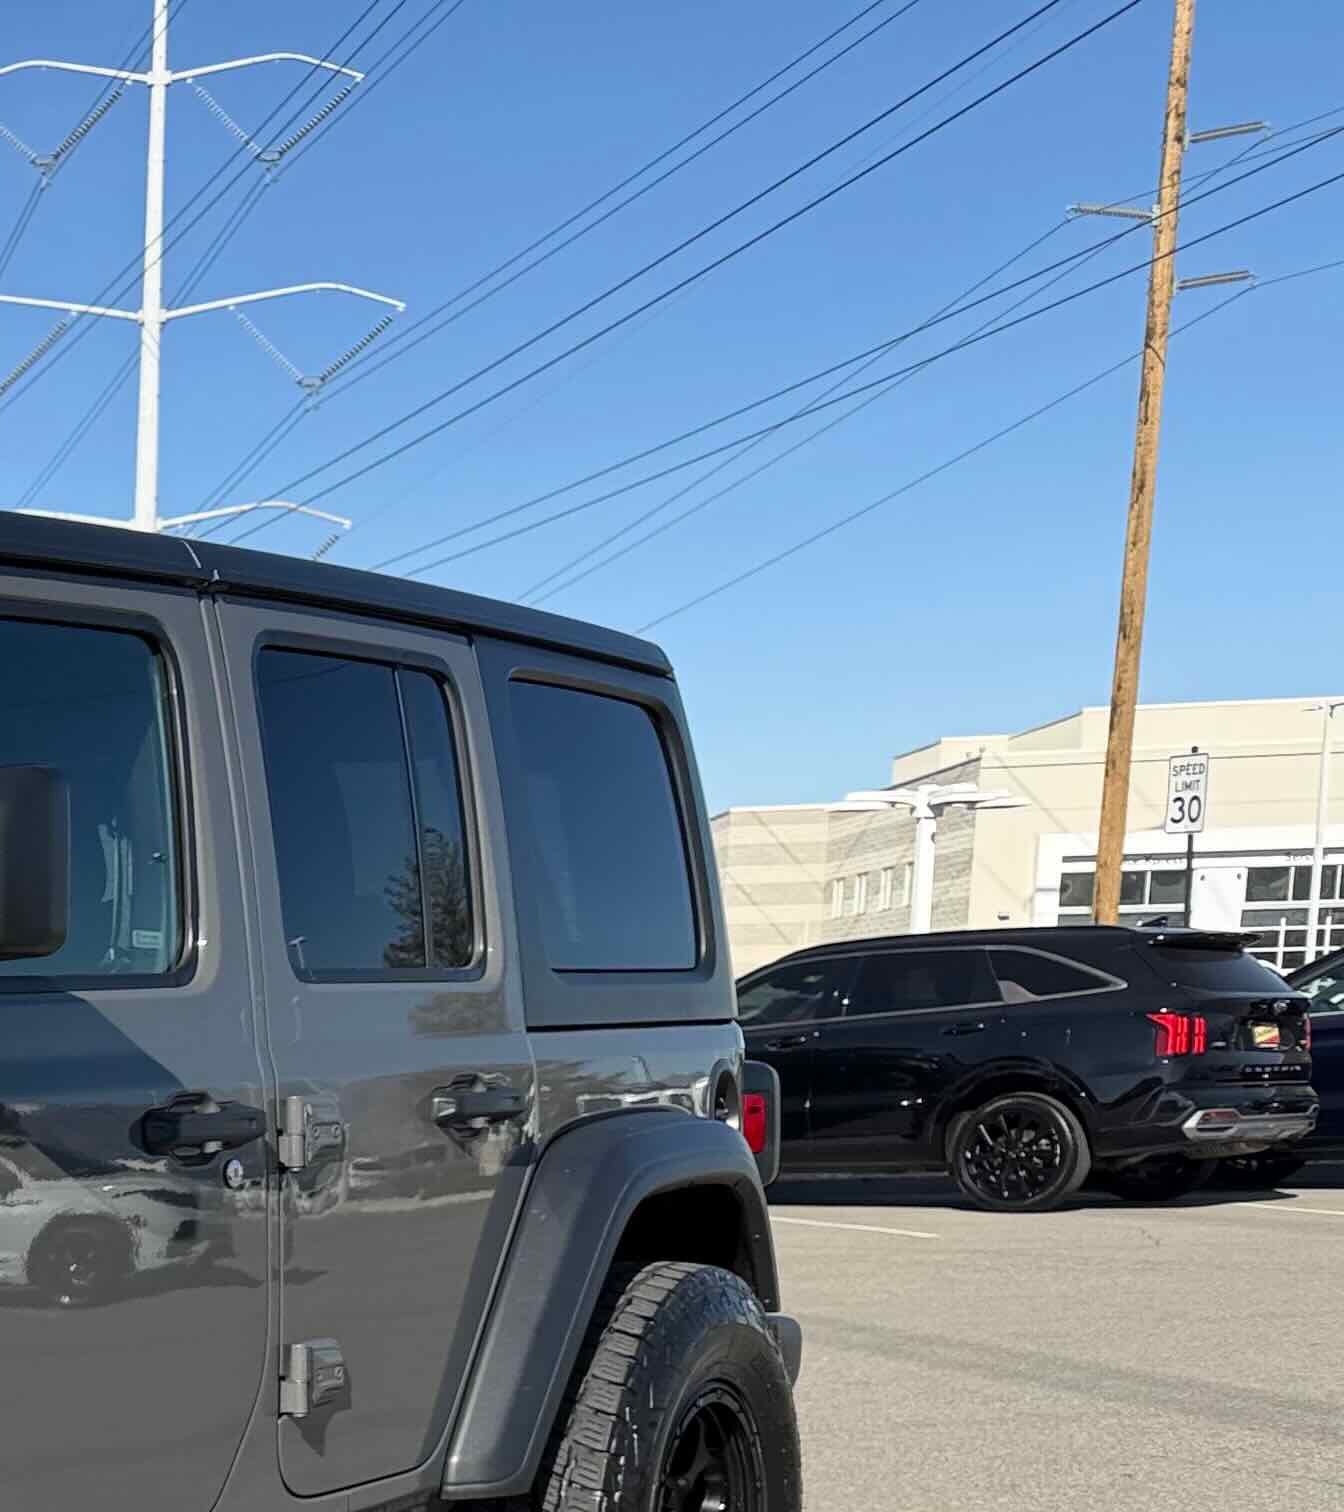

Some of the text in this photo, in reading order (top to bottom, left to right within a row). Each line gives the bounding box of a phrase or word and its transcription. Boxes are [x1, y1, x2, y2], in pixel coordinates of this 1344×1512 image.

[1172, 763, 1205, 777] SPEED
[1174, 779, 1201, 793] LIMIT
[1170, 795, 1202, 824] 30
